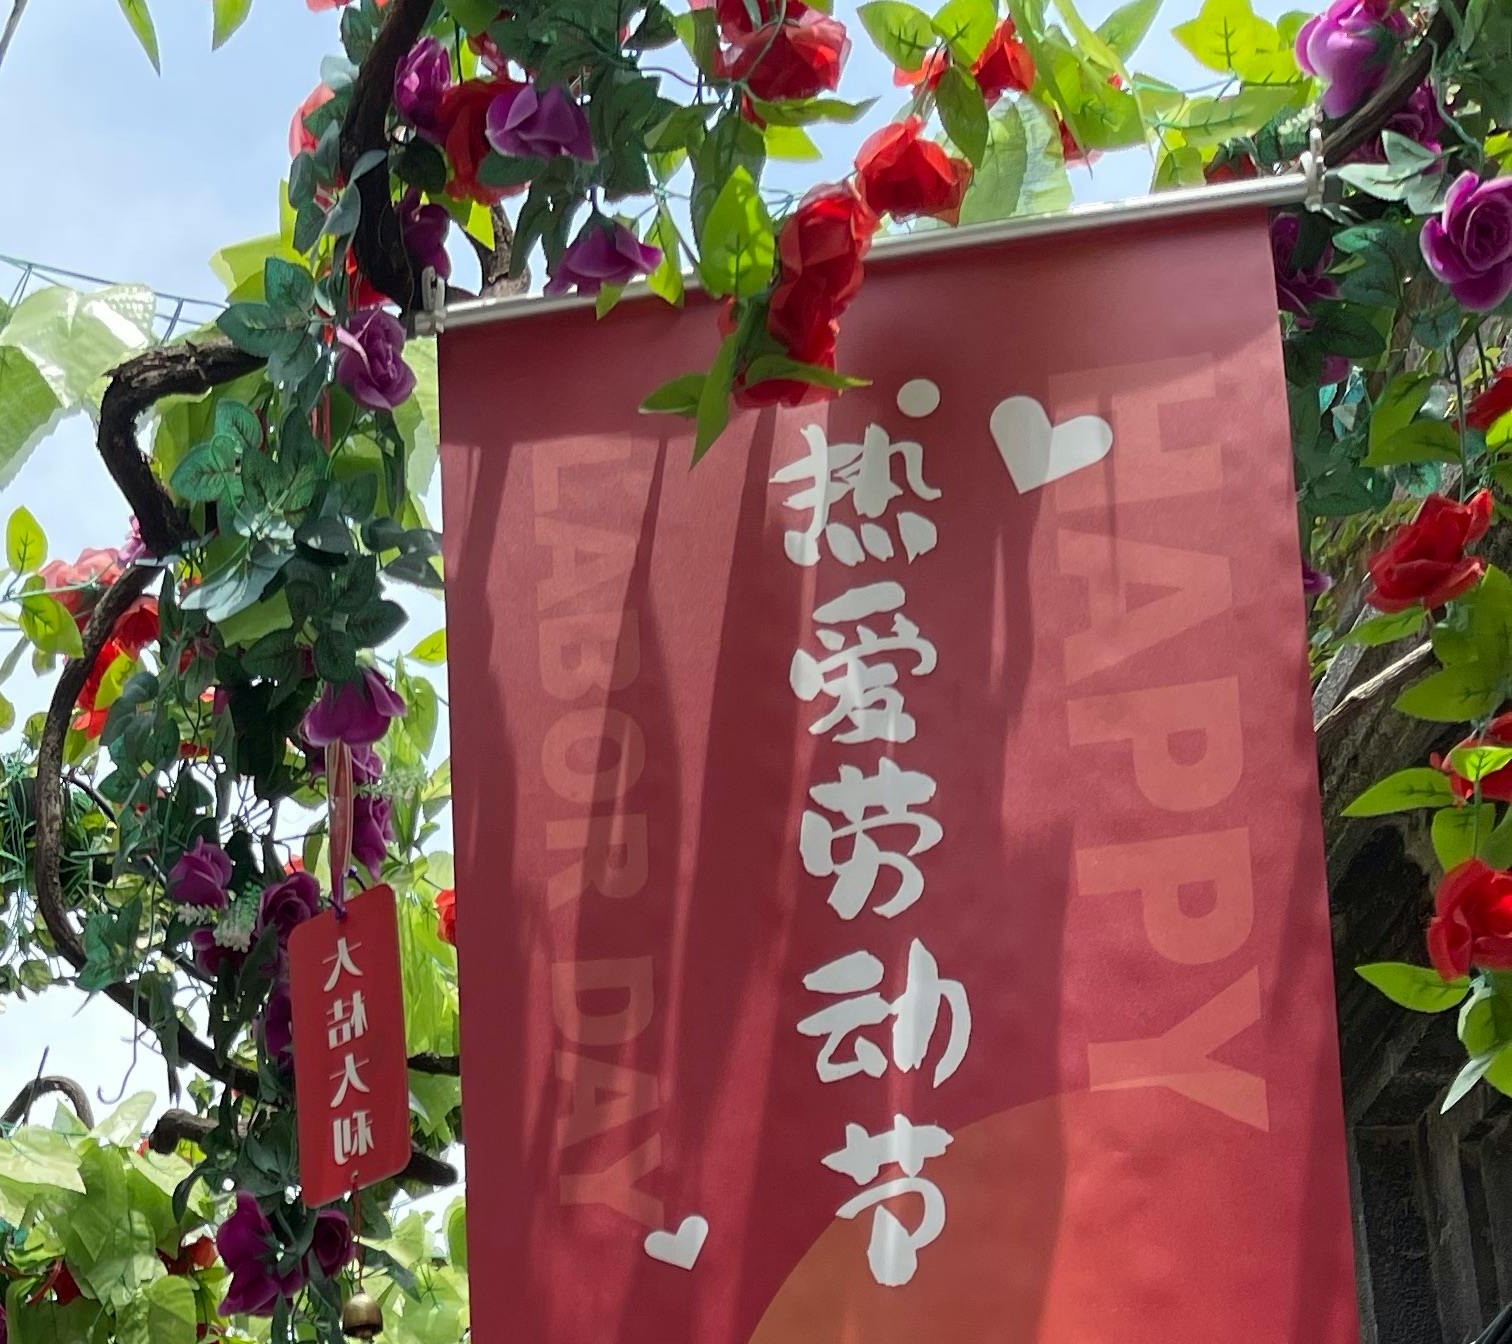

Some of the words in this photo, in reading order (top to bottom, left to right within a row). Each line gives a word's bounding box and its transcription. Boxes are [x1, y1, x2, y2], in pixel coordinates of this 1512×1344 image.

[529, 428, 648, 914] LABOR
[768, 420, 972, 1288] 热爱劳动节
[1047, 350, 1271, 1133] HAPPY
[548, 955, 665, 1228] DAY
